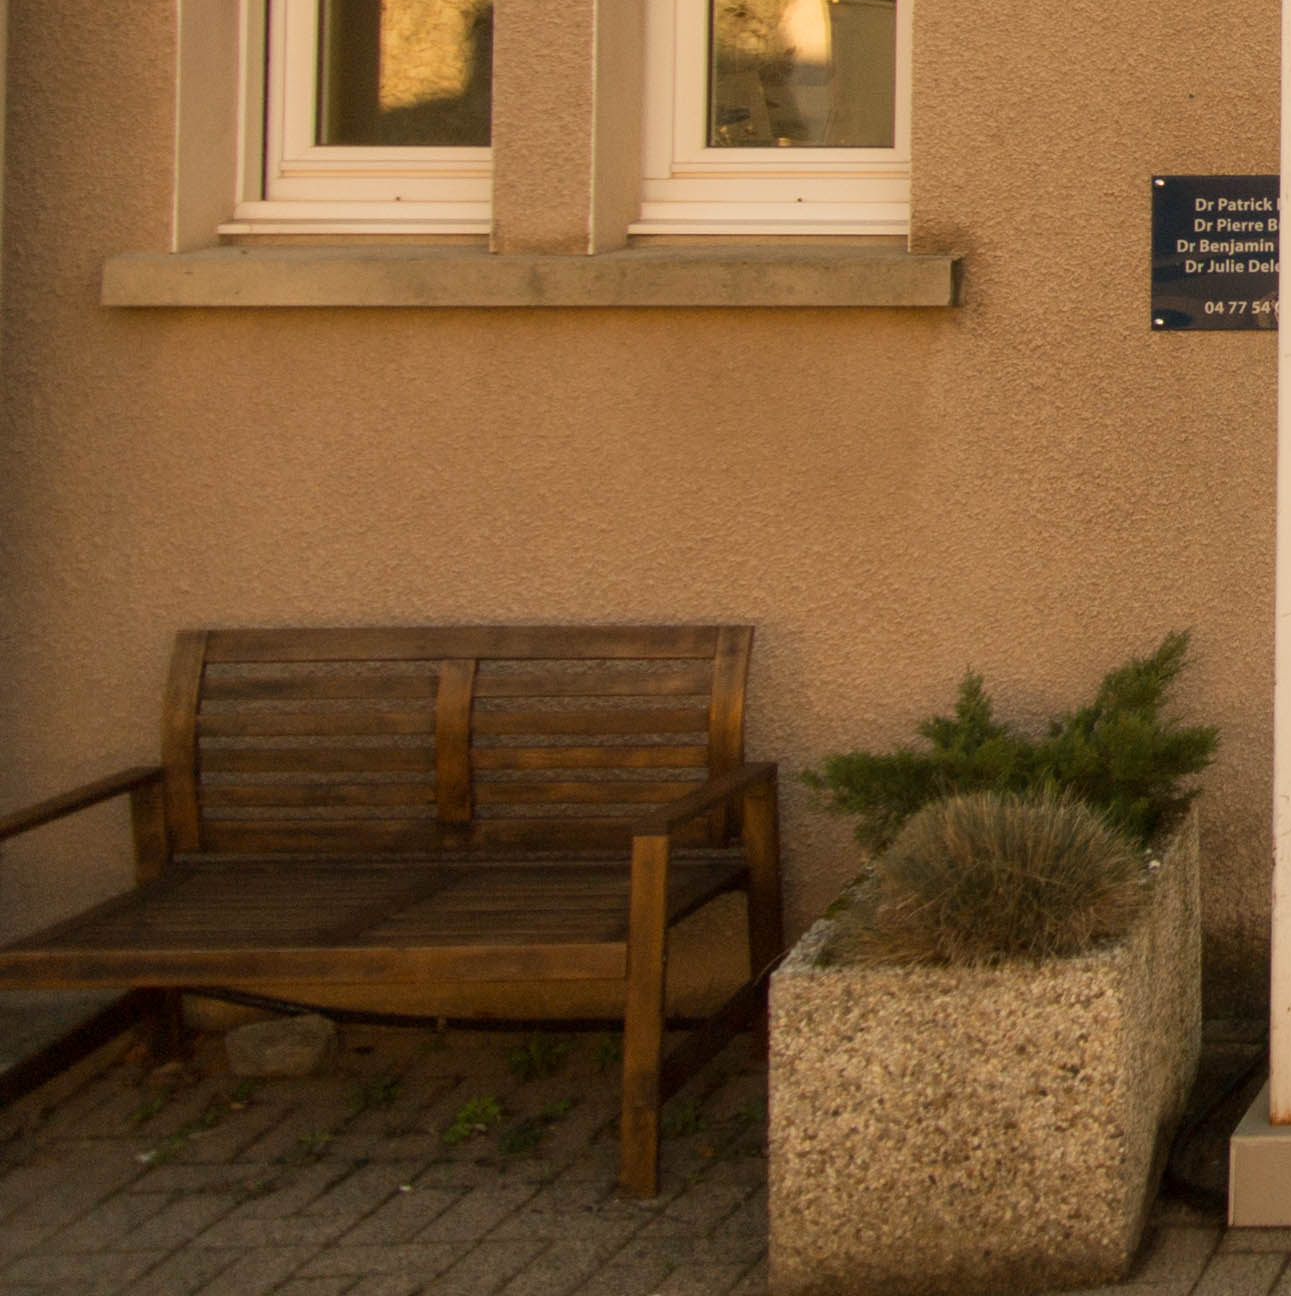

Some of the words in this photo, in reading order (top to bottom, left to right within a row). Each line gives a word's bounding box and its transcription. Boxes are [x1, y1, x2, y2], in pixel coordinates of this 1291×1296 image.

[1194, 198, 1214, 212] Dr
[1217, 197, 1273, 212] Patrick
[1193, 218, 1213, 232] Dr
[1216, 218, 1264, 232] Pierre
[1267, 218, 1280, 232] B
[1176, 239, 1196, 253] Dr
[1199, 238, 1274, 255] Benjamin
[1185, 260, 1204, 273] Dr
[1207, 259, 1244, 273] Julie
[1204, 301, 1225, 314] 04
[1228, 301, 1248, 314] 77
[1251, 301, 1271, 314] 54
